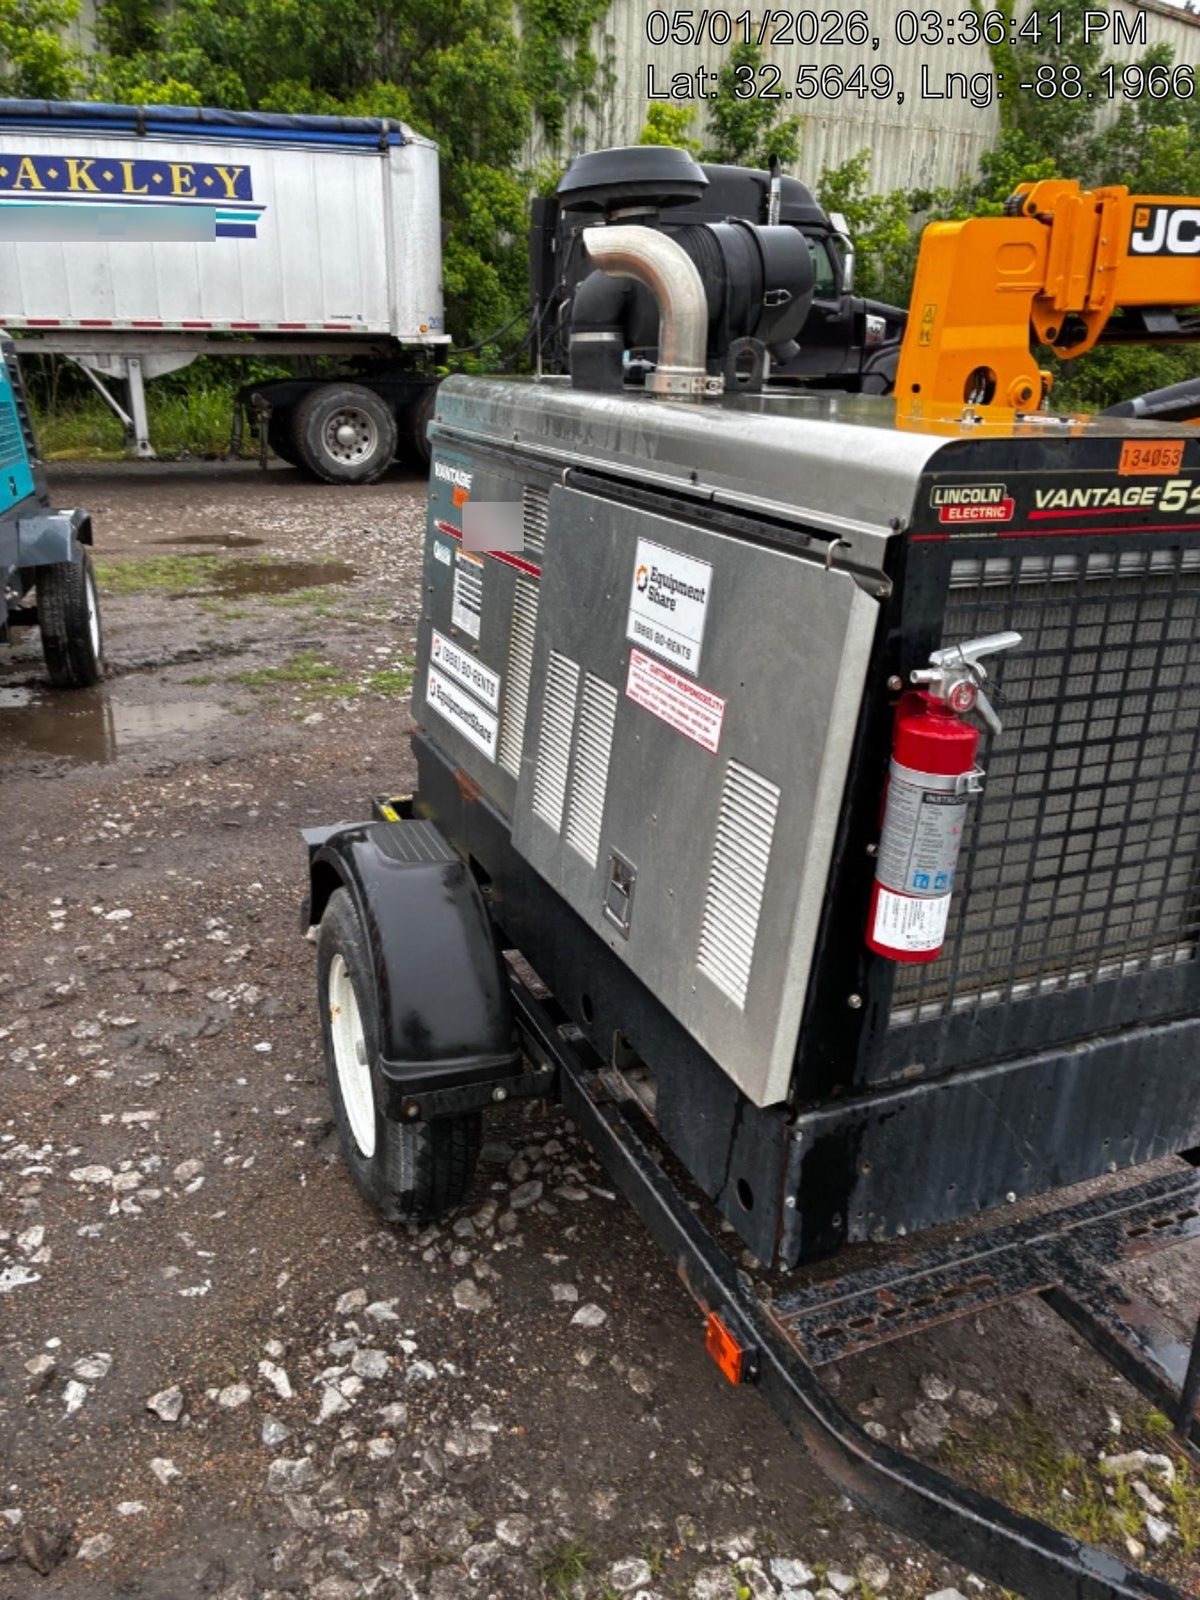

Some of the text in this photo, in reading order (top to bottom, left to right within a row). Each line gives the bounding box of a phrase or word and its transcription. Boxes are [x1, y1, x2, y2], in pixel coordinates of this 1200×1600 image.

[1121, 448, 1181, 468] 134053
[934, 487, 1002, 504] LINCOLN
[1034, 486, 1158, 509] VANTAGE
[948, 506, 1006, 520] ELECTRIC
[650, 566, 706, 604] Equipment
[647, 586, 677, 612] Share
[436, 683, 494, 744] EquipmentShare
